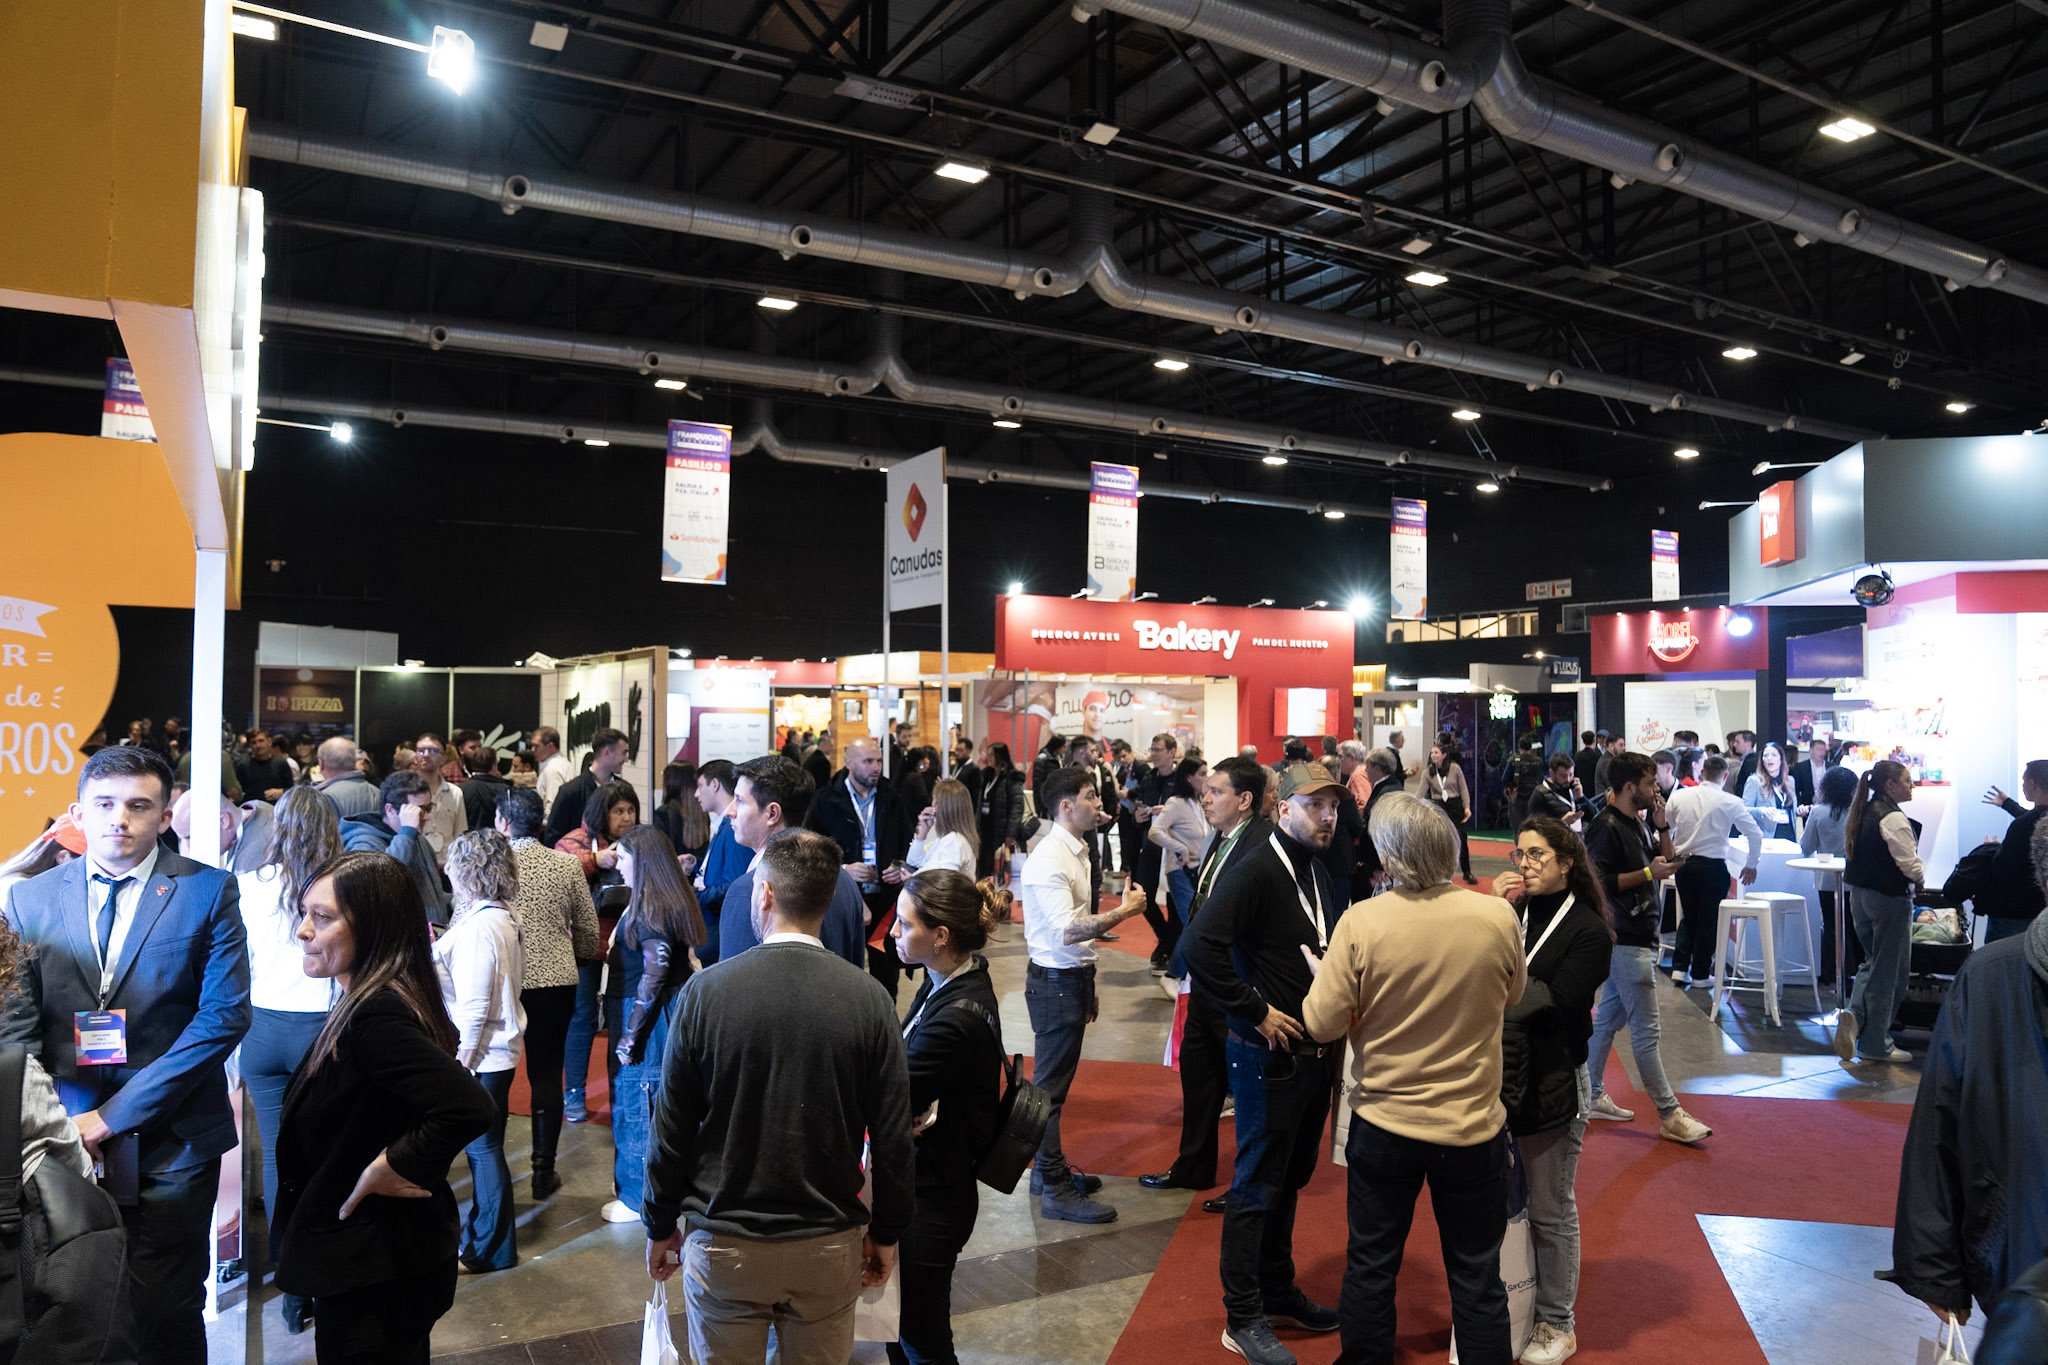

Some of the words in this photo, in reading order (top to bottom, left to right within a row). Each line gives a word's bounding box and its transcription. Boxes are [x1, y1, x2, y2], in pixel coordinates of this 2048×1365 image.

[114, 403, 149, 416] PASI
[674, 458, 713, 471] PASILLO
[714, 462, 722, 472] D
[890, 548, 943, 577] Canudas
[3, 603, 25, 623] OS
[1031, 629, 1080, 640] BUENOS
[1082, 631, 1120, 642] AYRES
[1133, 620, 1240, 660] Bakery
[1252, 638, 1270, 647] PAN
[1271, 639, 1288, 648] DEL
[1289, 639, 1329, 649] NUESTRO
[1, 644, 29, 667] R
[5, 684, 45, 707] de
[0, 722, 75, 775] ROS
[1507, 1276, 1537, 1292] SanCorSa
